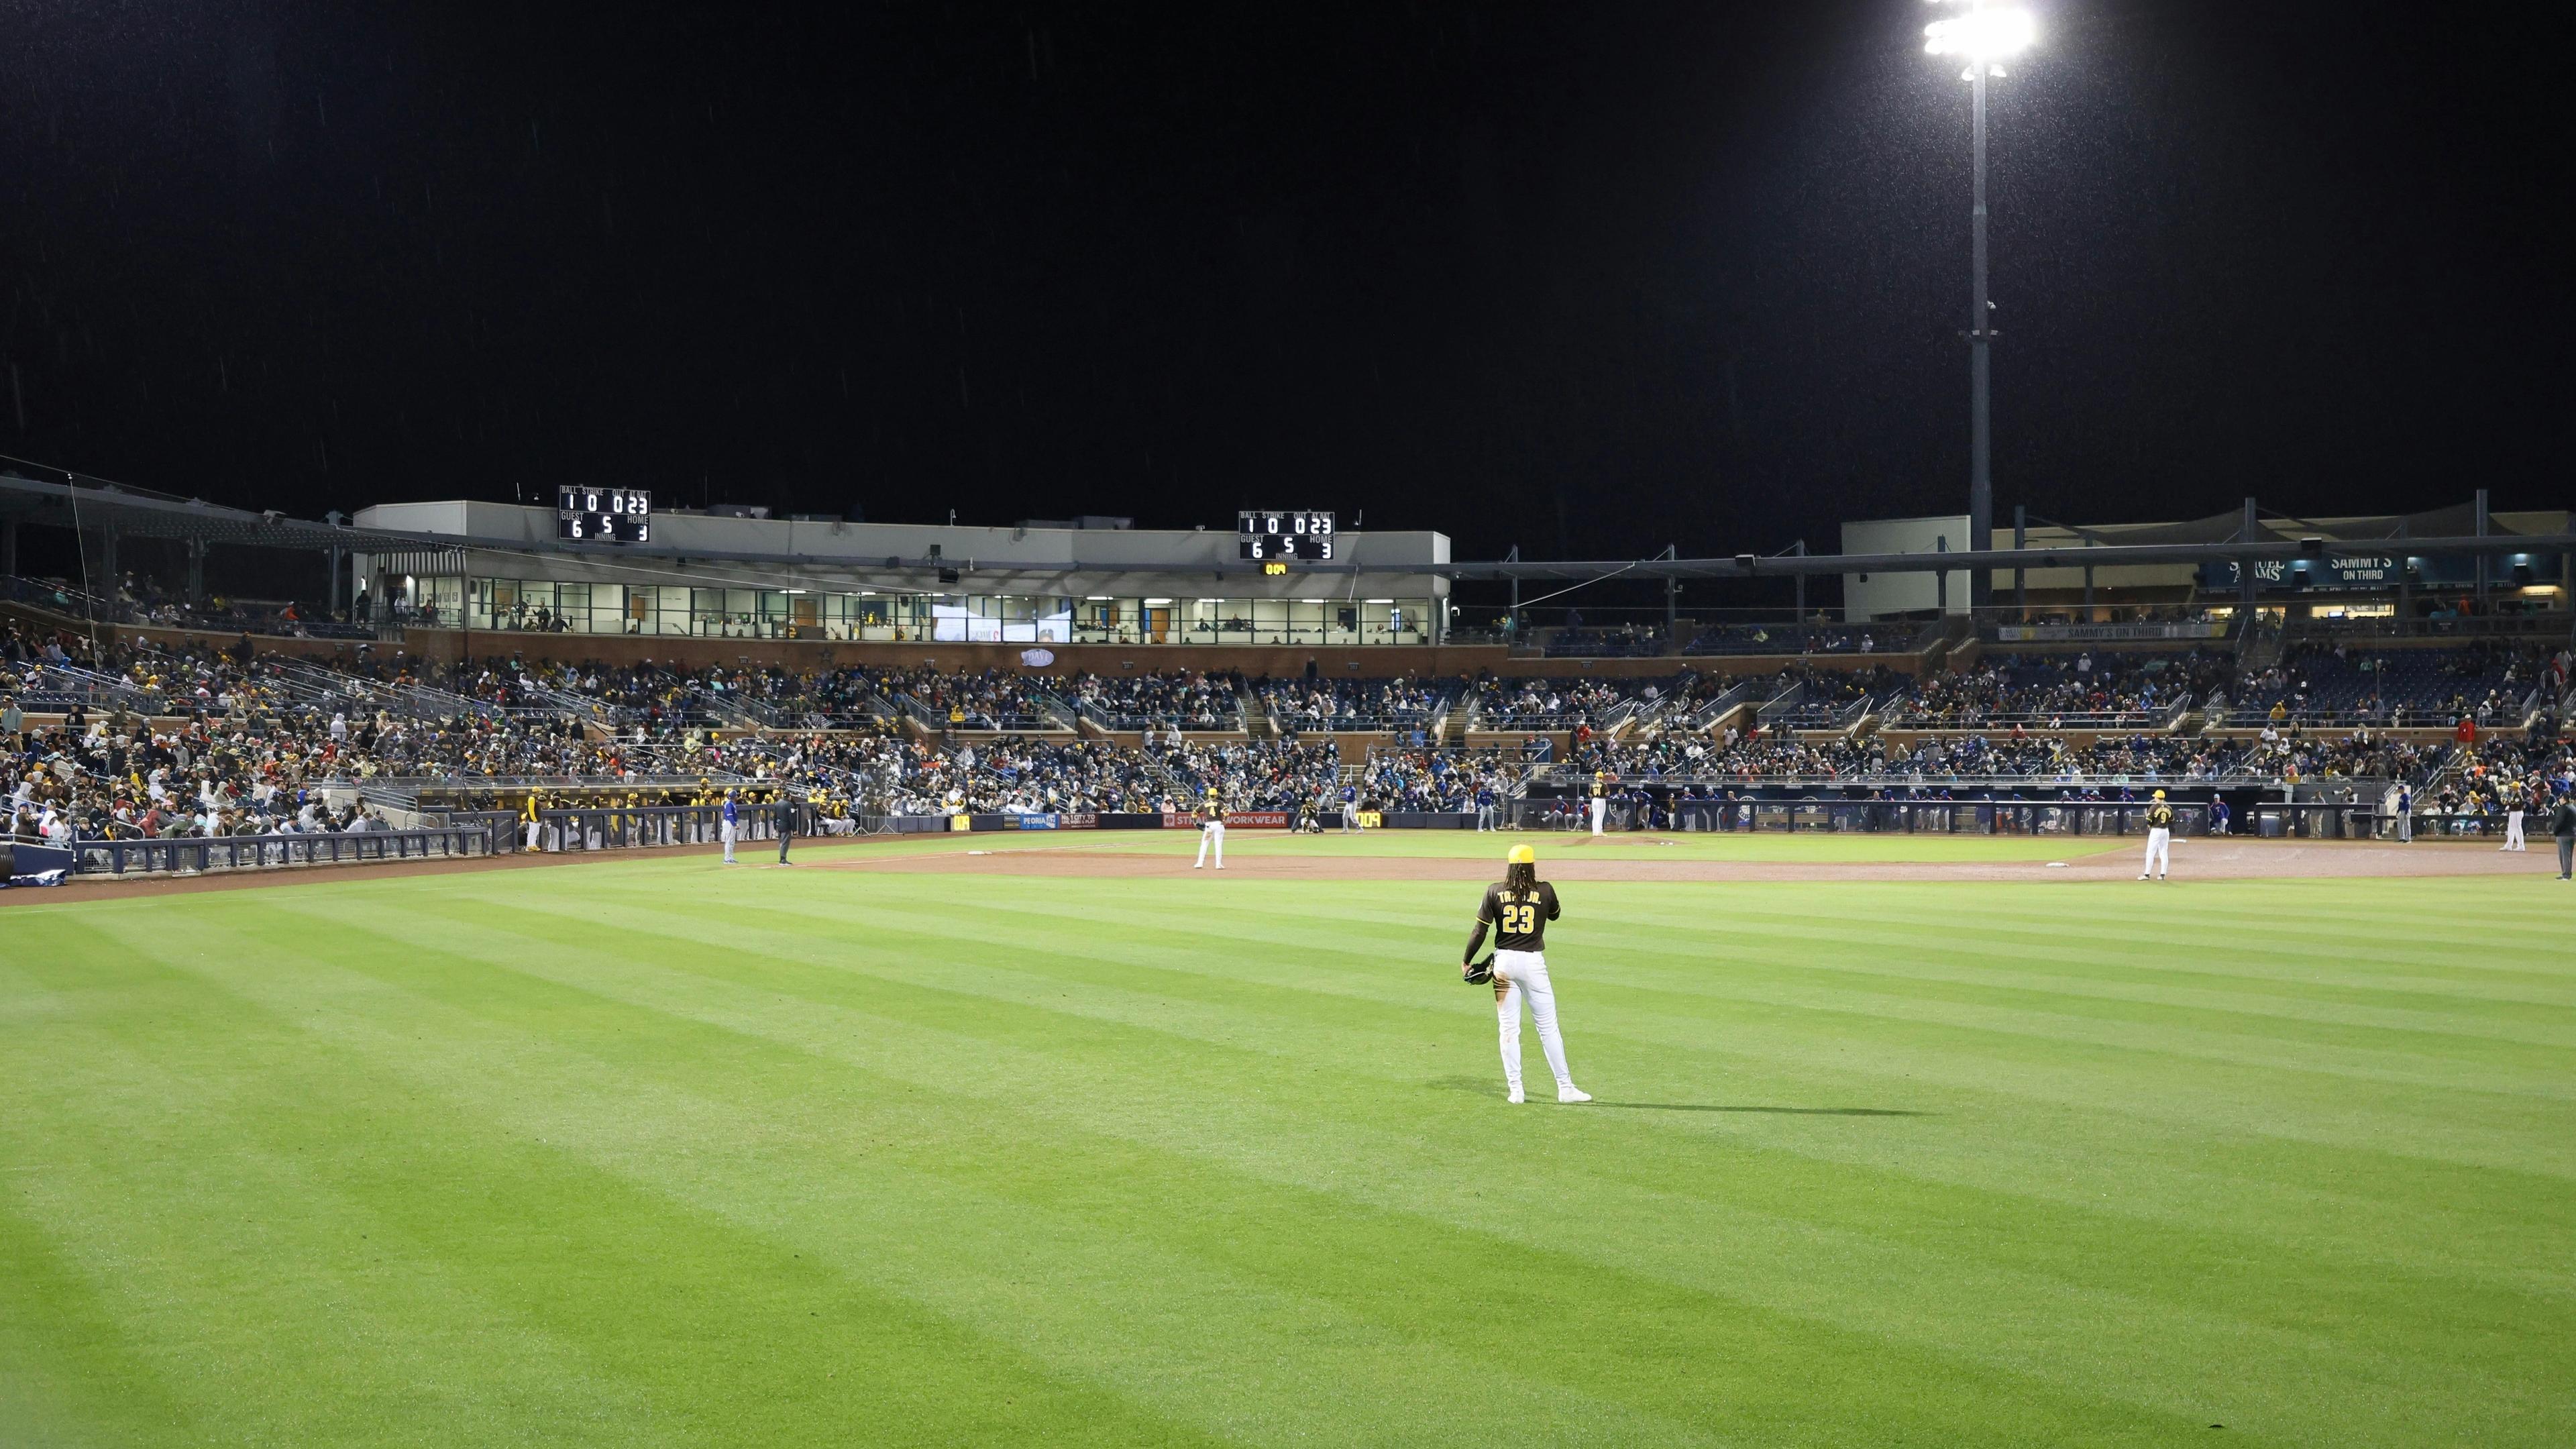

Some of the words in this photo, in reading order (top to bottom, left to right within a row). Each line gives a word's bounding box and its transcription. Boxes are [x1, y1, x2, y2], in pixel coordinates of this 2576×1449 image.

[582, 488, 604, 496] STRIKE
[570, 494, 574, 509] 1
[588, 494, 597, 511] 0
[614, 496, 623, 513] 0
[629, 497, 647, 514] 23
[561, 512, 584, 521] GUEST
[627, 515, 648, 525] HOME
[603, 516, 612, 533] 5
[1249, 519, 1253, 533] 1
[1268, 518, 1278, 534] 0
[1295, 518, 1305, 534] 0
[1311, 519, 1331, 534] 23
[573, 521, 582, 538] 6
[639, 525, 647, 541] 3
[594, 533, 616, 541] INNING
[1241, 535, 1264, 543] GUEST
[1310, 535, 1332, 543] HOME
[1284, 537, 1294, 553] 5
[1252, 543, 1263, 558] 6
[1322, 543, 1331, 559] 3
[2343, 570, 2355, 580] ON
[2357, 570, 2383, 580] THIRD
[2068, 628, 2113, 637] SAMMY'S
[2116, 627, 2129, 637] ON
[2133, 627, 2161, 637] THIRD
[2161, 812, 2167, 823] 9
[1527, 890, 1542, 905] JR.
[1503, 905, 1535, 934] 23
